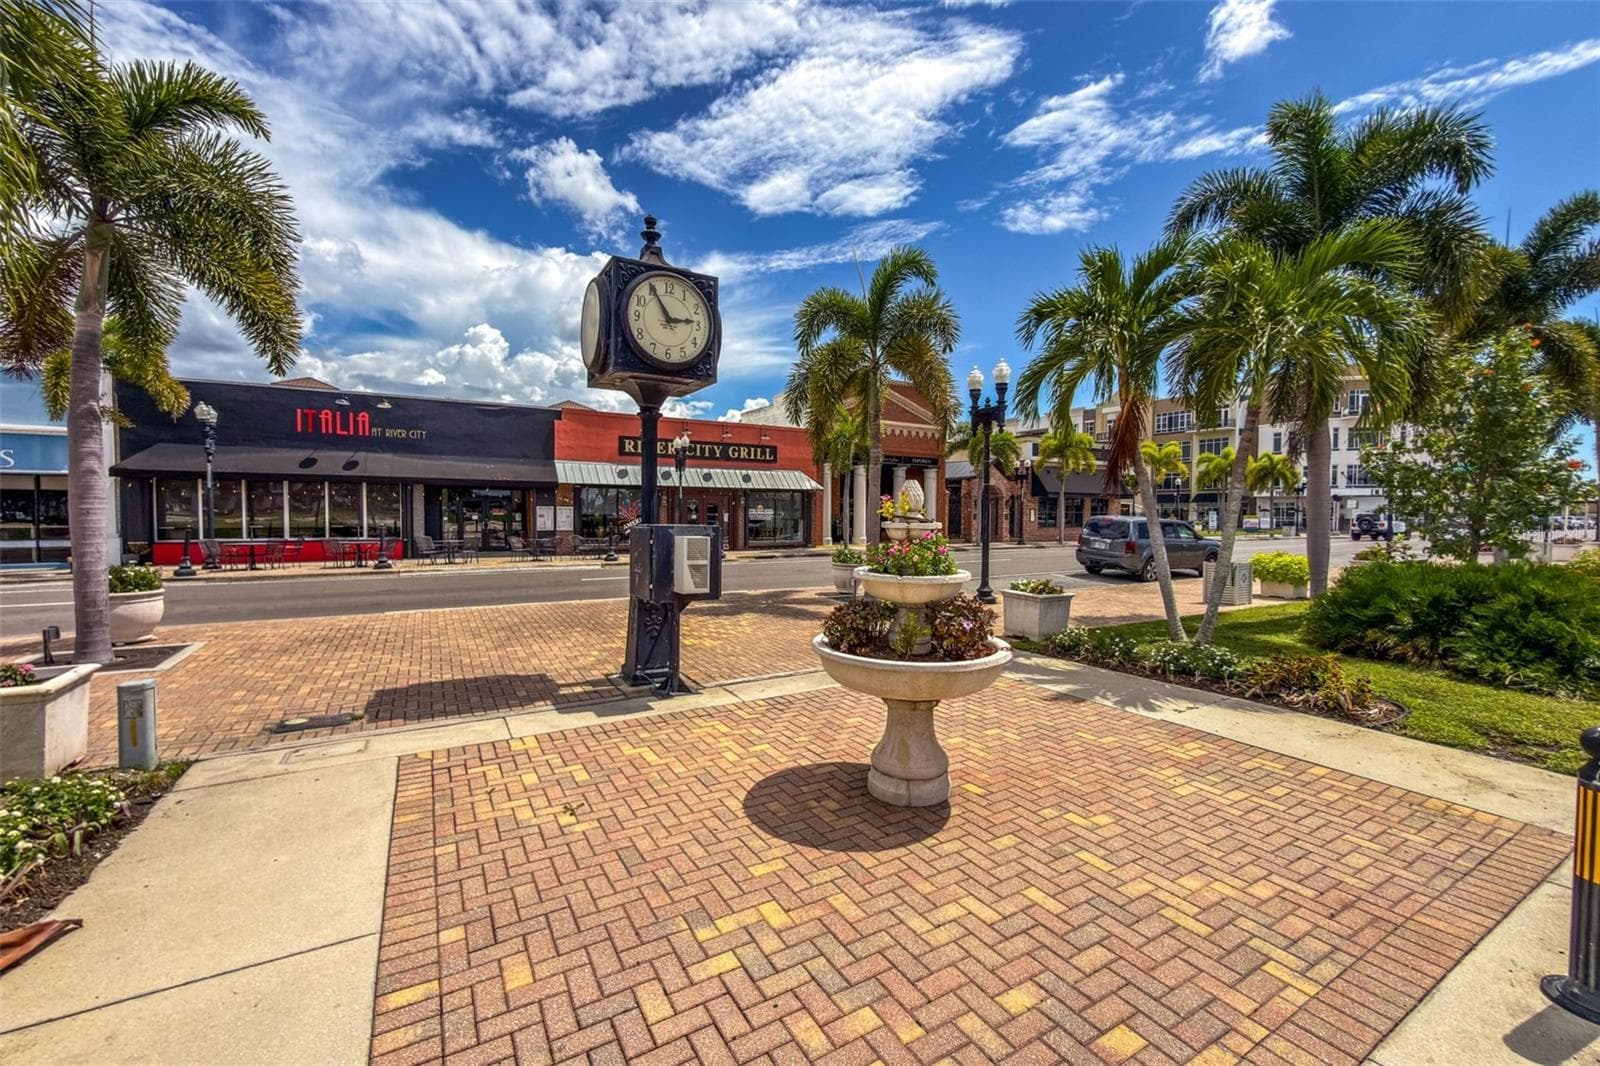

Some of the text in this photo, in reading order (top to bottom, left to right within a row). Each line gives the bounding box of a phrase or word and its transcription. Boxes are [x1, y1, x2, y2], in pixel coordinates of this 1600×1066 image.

[664, 282, 675, 295] 12
[636, 295, 645, 307] 10
[634, 310, 641, 321] 9
[693, 304, 699, 315] 2
[695, 320, 701, 332] 3
[636, 328, 643, 340] 8
[650, 342, 656, 354] 7
[691, 337, 697, 348] 4
[665, 348, 671, 359] 6
[680, 347, 686, 358] 5
[296, 408, 428, 440] ITALIA AT RIVER CITY
[623, 438, 774, 461] RIER CITY GRILL
